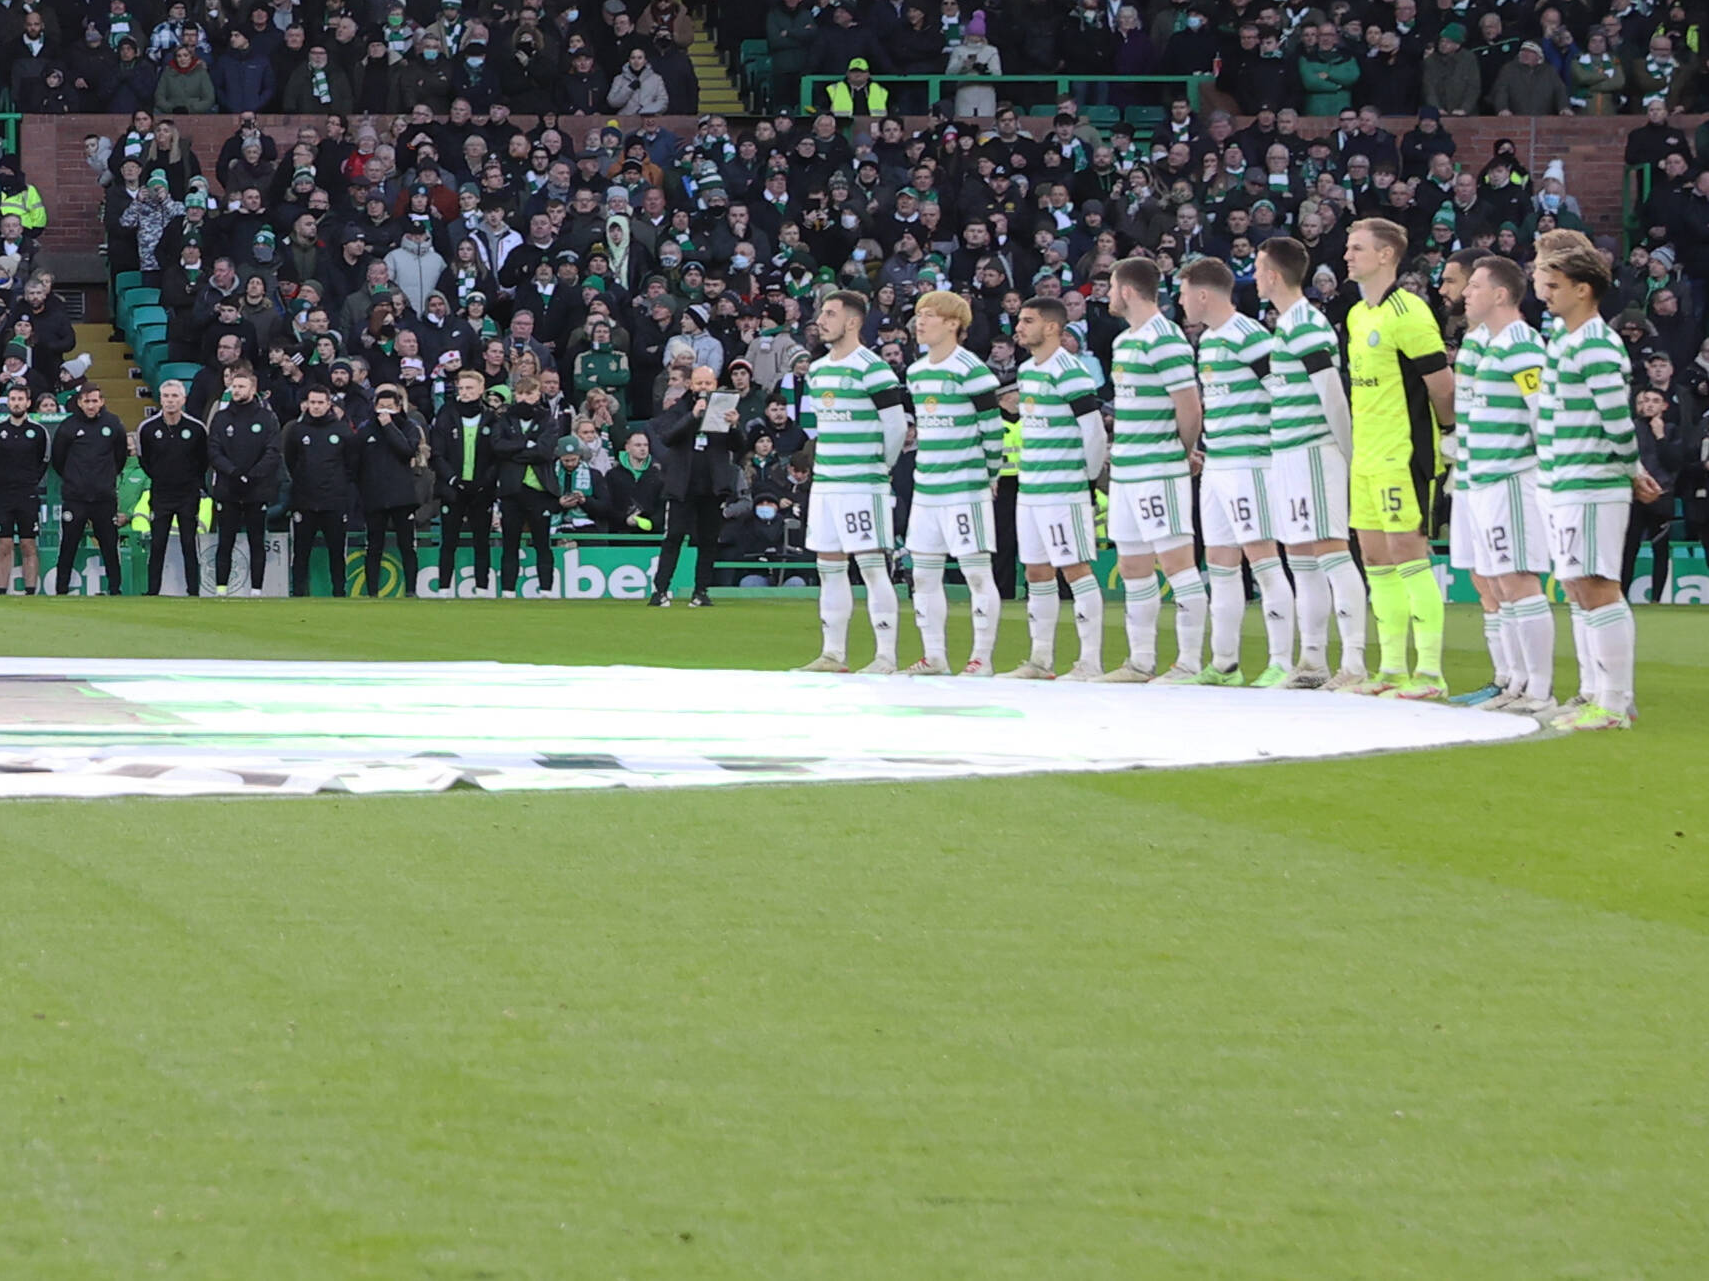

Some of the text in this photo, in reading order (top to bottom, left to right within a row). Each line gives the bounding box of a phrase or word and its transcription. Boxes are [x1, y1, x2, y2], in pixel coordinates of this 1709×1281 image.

[1524, 373, 1537, 390] C
[1139, 495, 1165, 520] 56
[1230, 497, 1252, 523] 16
[1290, 497, 1309, 522] 14
[1382, 487, 1403, 511] 15
[845, 510, 872, 533] 88
[956, 513, 971, 535] 8
[1050, 523, 1068, 546] 11
[1559, 527, 1578, 554] 17
